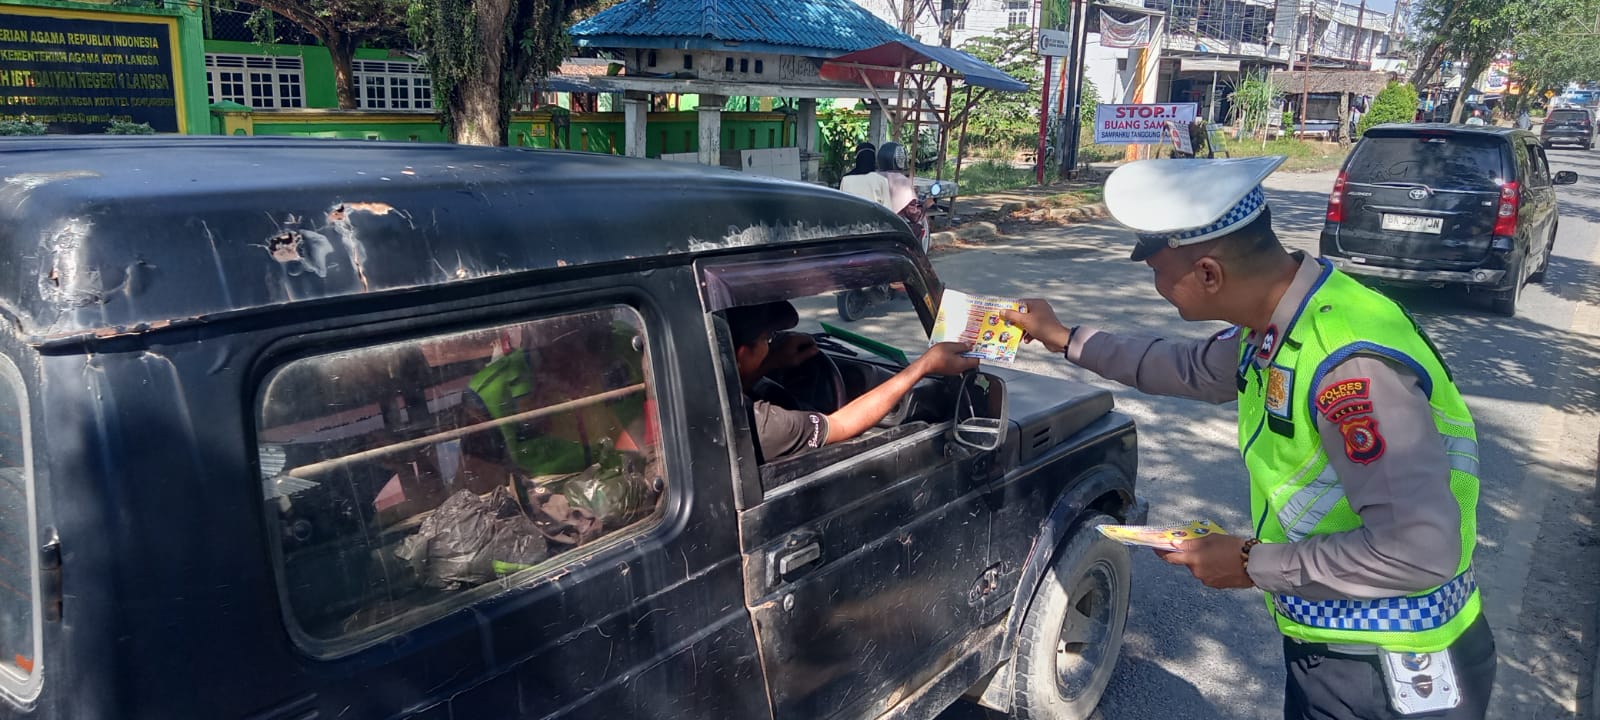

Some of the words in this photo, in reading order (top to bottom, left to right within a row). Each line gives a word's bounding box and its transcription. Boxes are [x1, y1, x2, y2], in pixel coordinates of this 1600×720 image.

[30, 31, 66, 44] AGAMA
[67, 33, 112, 47] REPUBLIK
[112, 35, 159, 49] INDONESIA
[1, 50, 67, 63] KEMENTERIAN
[68, 52, 99, 64] AGAMA
[101, 53, 124, 65] KOTA
[125, 55, 159, 66] LANGSA
[76, 72, 118, 89] NEGERI
[125, 73, 169, 90] LANGSA
[1104, 120, 1140, 130] BUANG
[1101, 131, 1130, 139] SAMPAHKU
[1131, 131, 1161, 139] TANGGUNG
[1319, 382, 1362, 405] POLRES
[1335, 405, 1364, 418] ACEH
